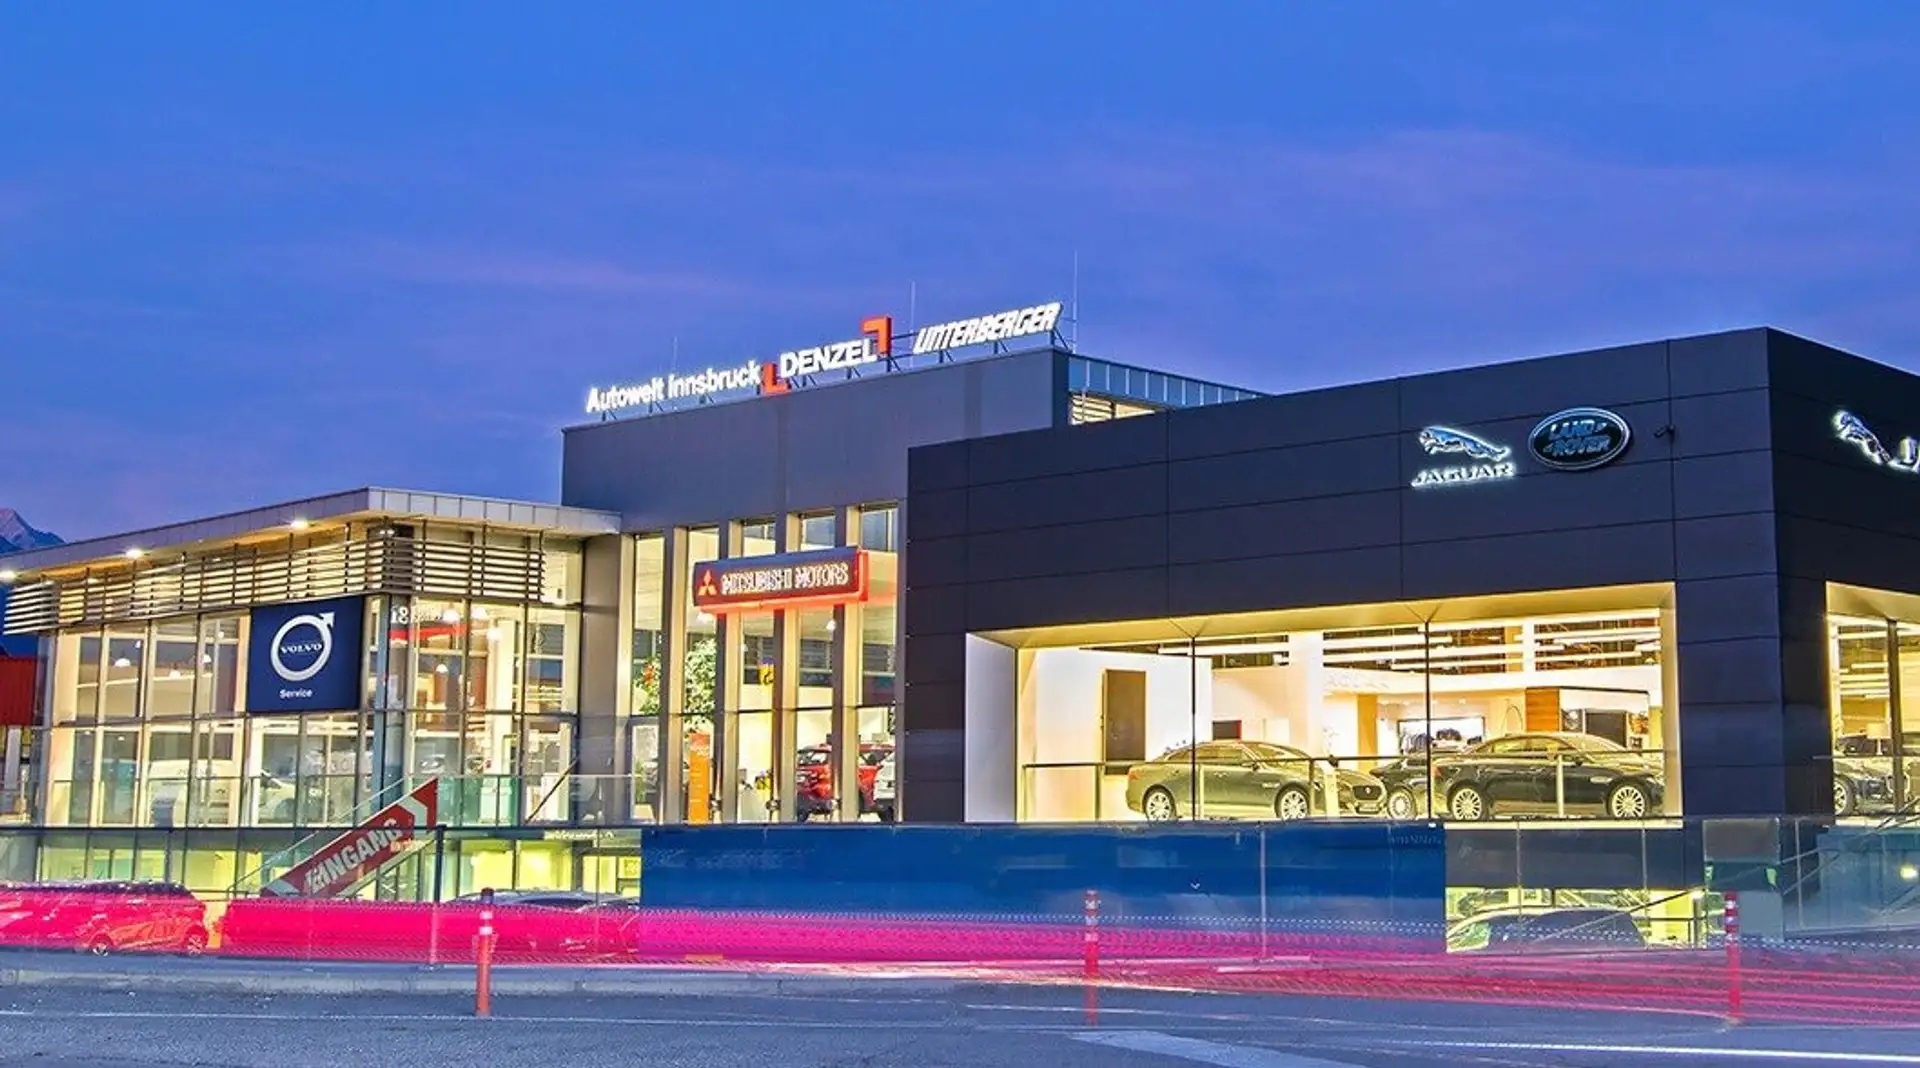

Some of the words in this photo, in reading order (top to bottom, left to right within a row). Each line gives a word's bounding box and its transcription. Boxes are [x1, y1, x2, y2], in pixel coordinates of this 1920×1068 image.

[912, 302, 1062, 354] UNTERBERGER
[780, 339, 877, 378] DENZEL
[586, 376, 665, 413] Autowelt
[1411, 462, 1517, 487] JAGUAR
[721, 567, 793, 596] MITSUBISHI
[794, 563, 849, 588] MOTORS
[281, 643, 323, 654] VOLVO
[279, 689, 313, 699] Service
